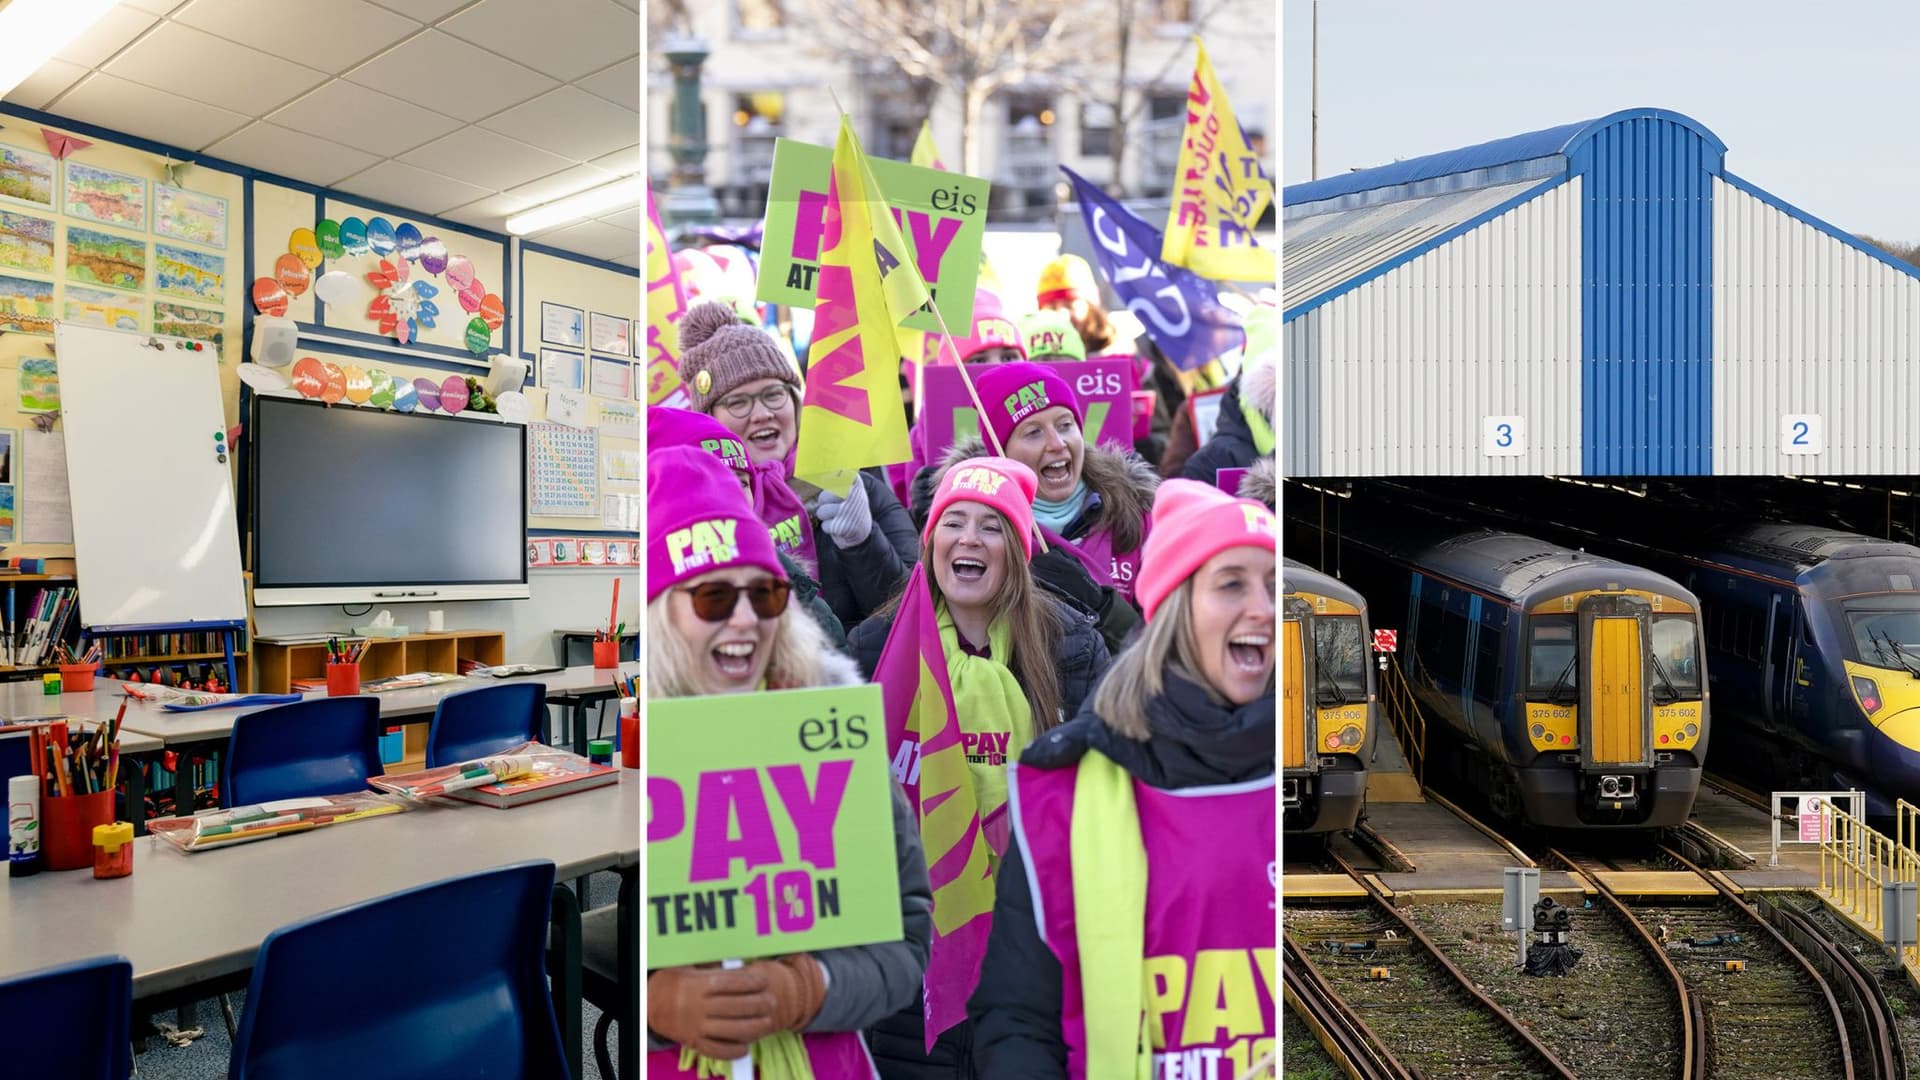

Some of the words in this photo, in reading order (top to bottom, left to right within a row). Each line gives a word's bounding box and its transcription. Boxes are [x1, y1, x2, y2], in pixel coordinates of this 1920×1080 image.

[931, 186, 977, 216] eis
[791, 189, 963, 284] PY
[1076, 368, 1121, 395] eis
[1004, 380, 1047, 416] PAY
[1496, 424, 1512, 447] 3
[1792, 422, 1809, 445] 2
[952, 468, 1009, 489] PAY
[665, 519, 738, 563] PAY
[1109, 557, 1133, 581] is
[1323, 711, 1341, 720] 375
[1344, 710, 1361, 719] 906
[1532, 709, 1549, 718] 375
[1553, 709, 1570, 718] 602
[1659, 708, 1676, 717] 375
[1679, 708, 1696, 717] 602
[798, 707, 869, 752] eis
[960, 731, 1010, 754] PAY
[966, 752, 1006, 765] TENT10N
[647, 870, 841, 938] TENT10N
